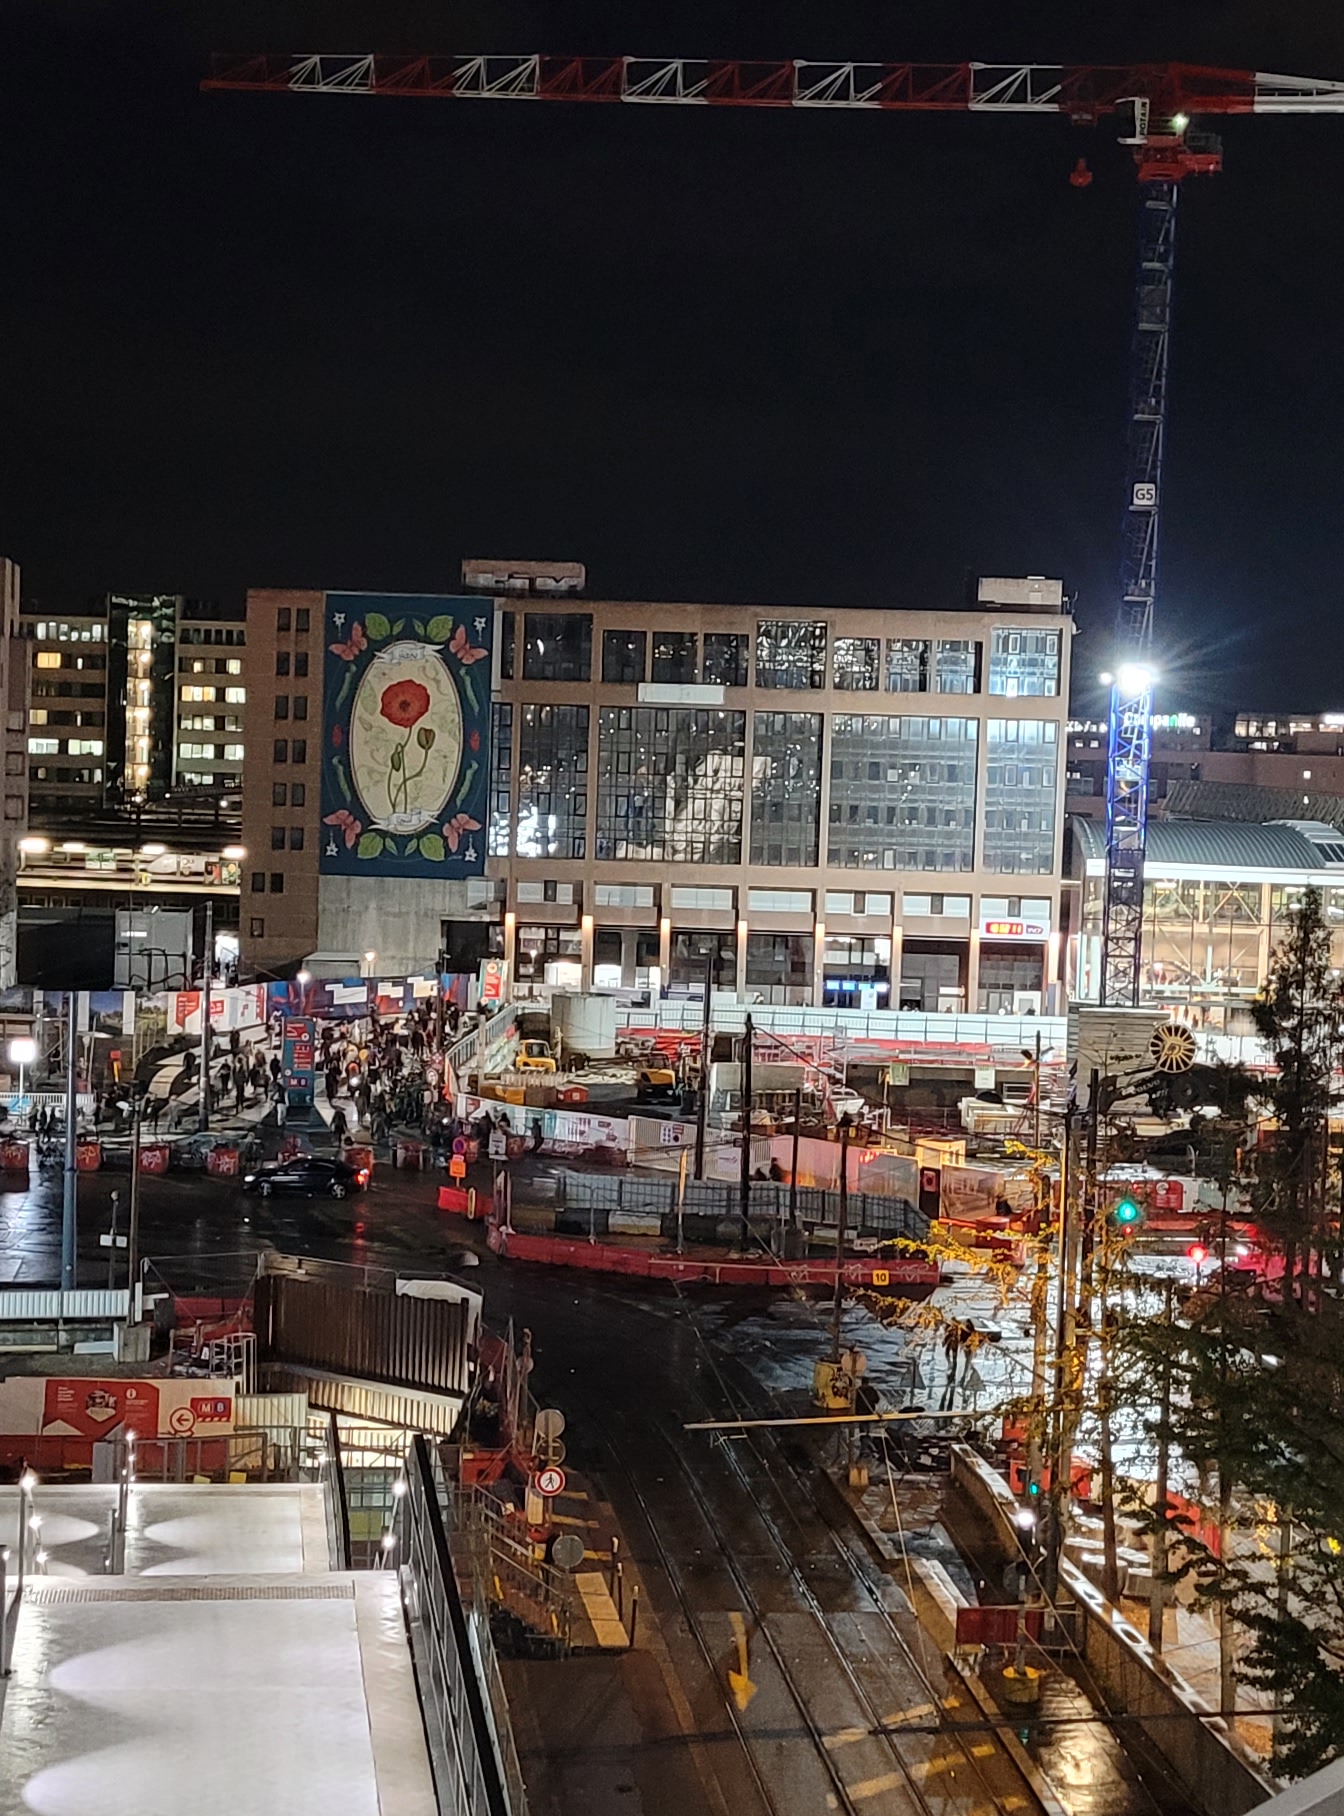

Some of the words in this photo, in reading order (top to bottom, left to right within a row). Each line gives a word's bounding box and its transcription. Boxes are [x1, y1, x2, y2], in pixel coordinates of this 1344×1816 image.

[1139, 101, 1147, 136] POTAIN
[1135, 488, 1154, 501] G5
[875, 1273, 887, 1282] 10
[201, 1402, 211, 1413] M
